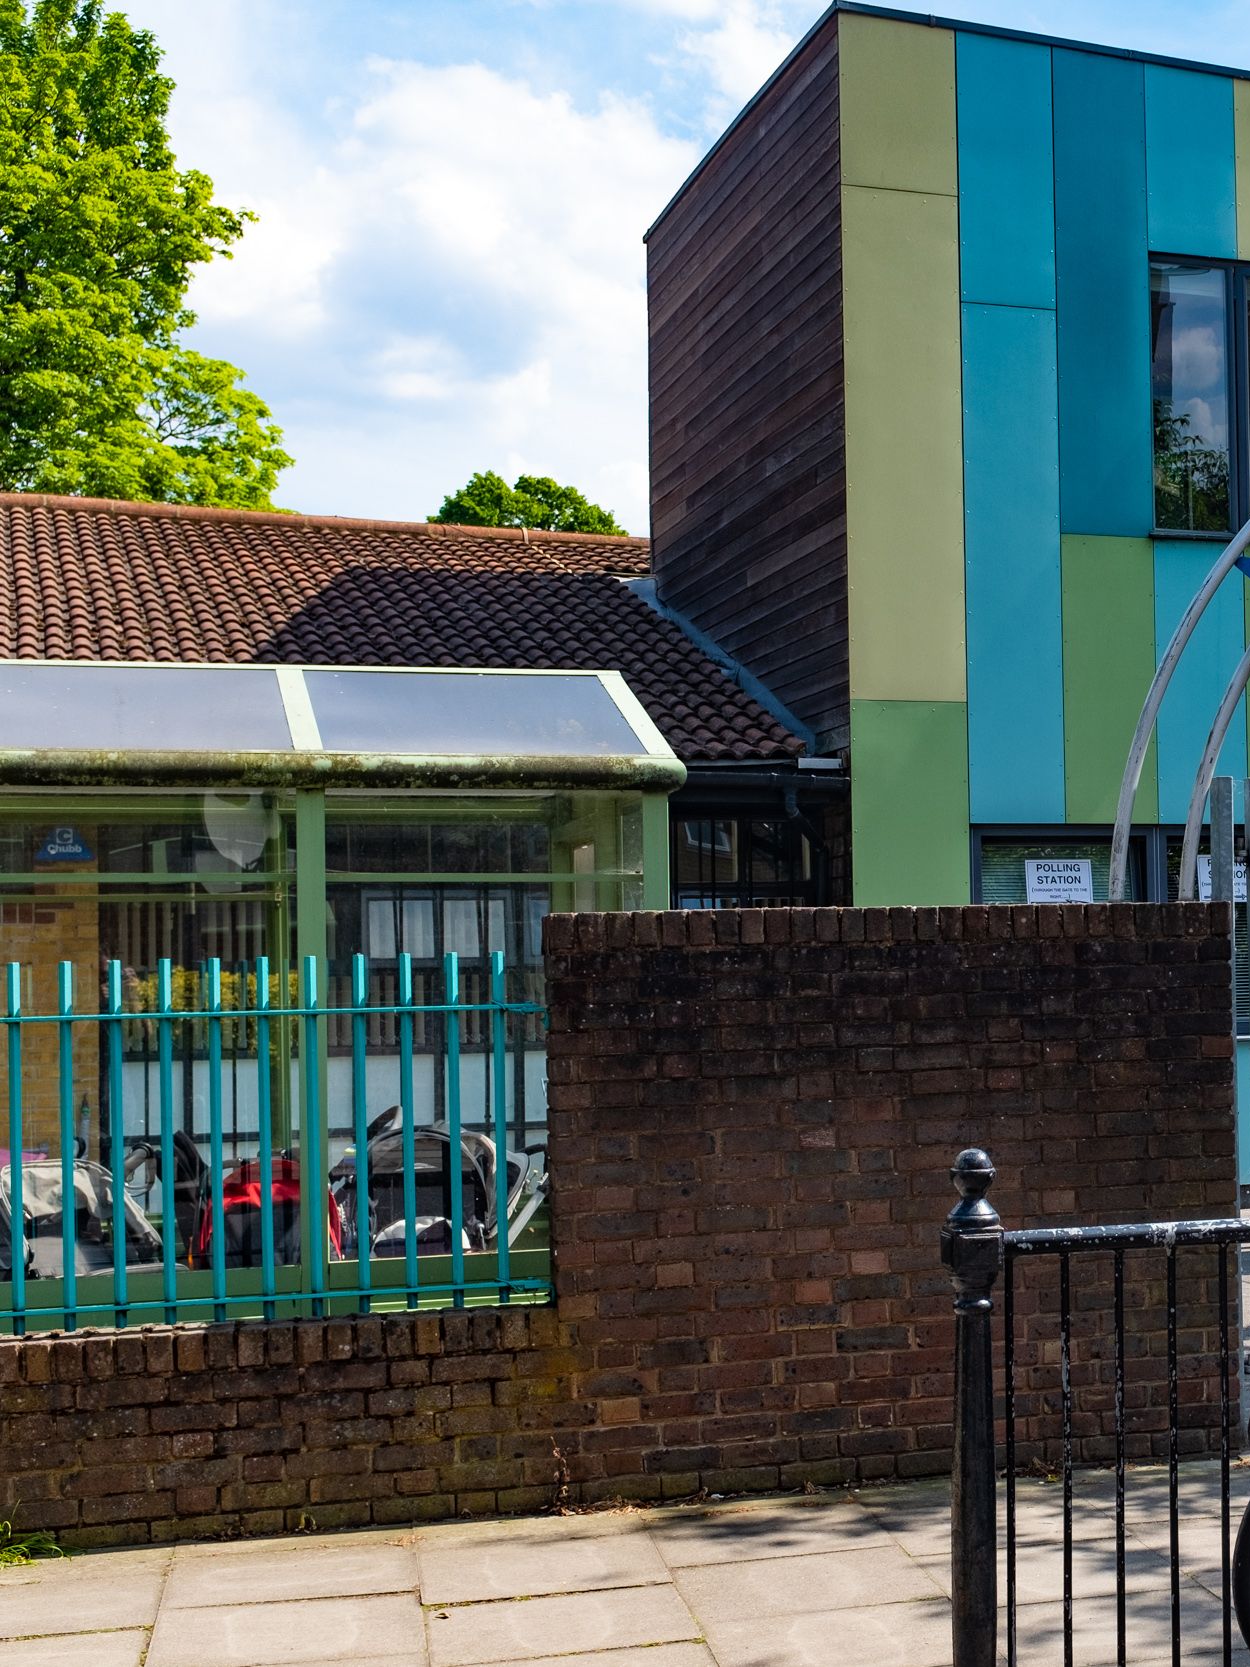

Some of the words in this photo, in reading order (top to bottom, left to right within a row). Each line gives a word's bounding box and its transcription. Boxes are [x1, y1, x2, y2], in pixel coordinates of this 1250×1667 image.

[48, 844, 82, 853] Chubb
[1036, 864, 1080, 872] POLLING
[1037, 876, 1081, 884] STATION
